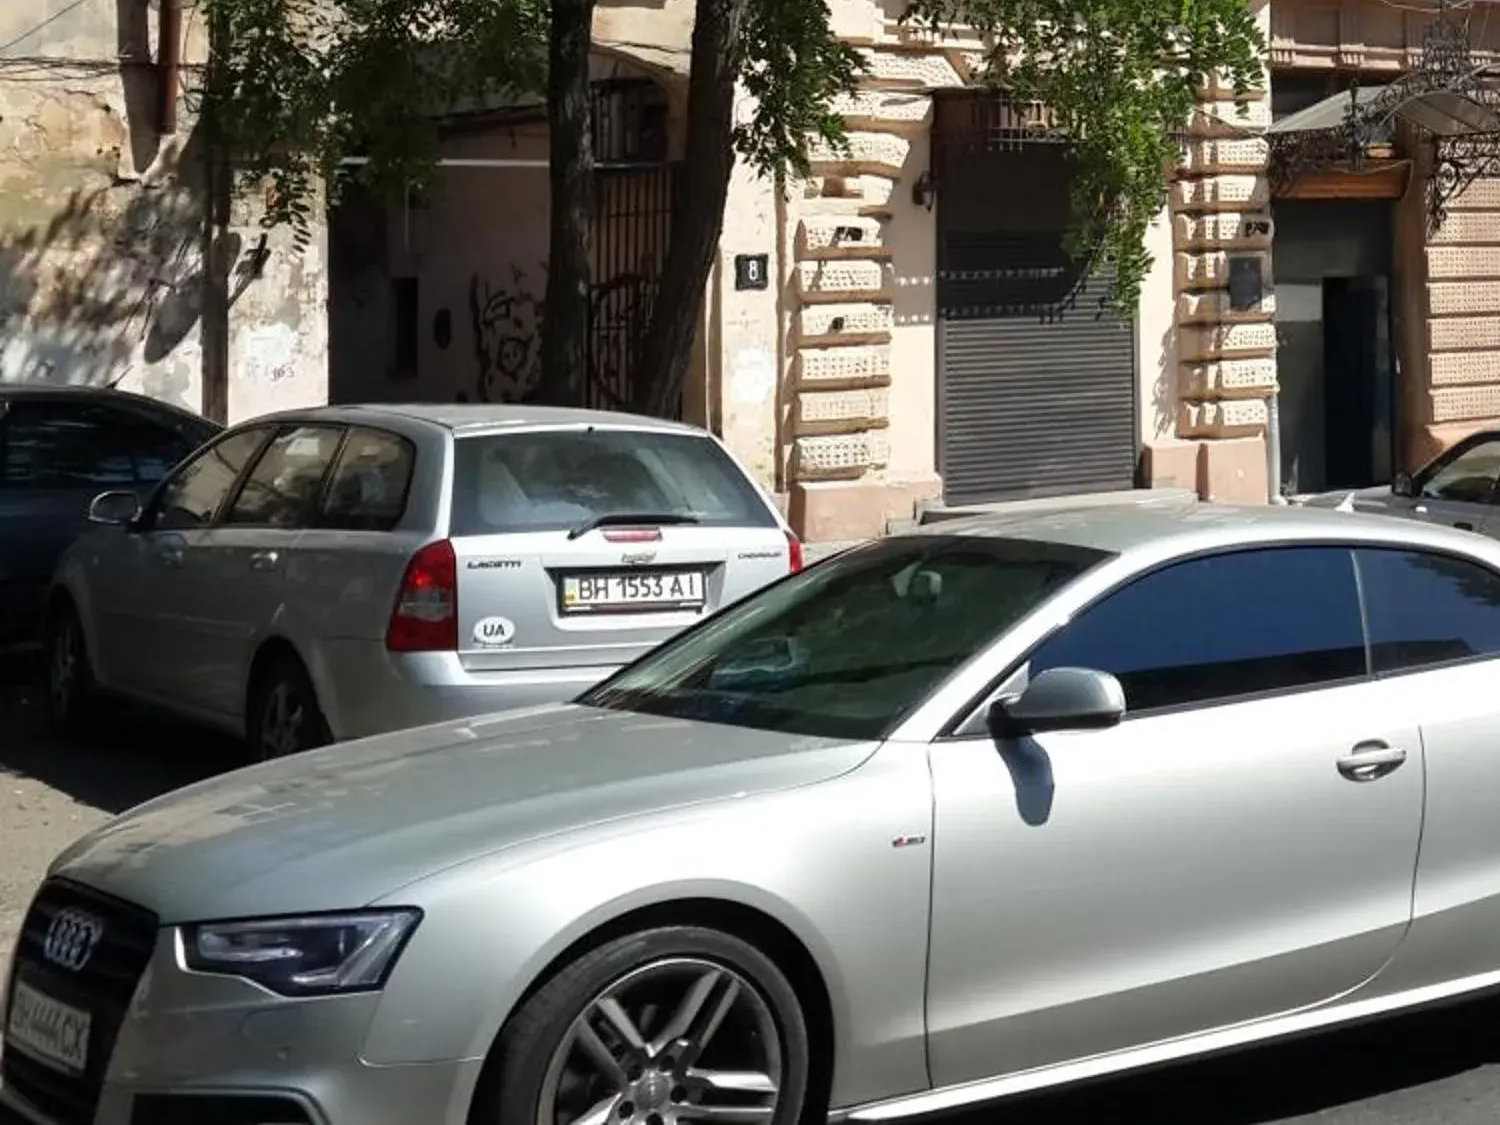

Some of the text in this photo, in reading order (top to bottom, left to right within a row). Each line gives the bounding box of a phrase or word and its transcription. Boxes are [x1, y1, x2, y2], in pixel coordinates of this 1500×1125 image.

[749, 260, 759, 281] 8
[580, 576, 609, 600] BH
[616, 575, 663, 598] 1553
[483, 624, 505, 637] UA
